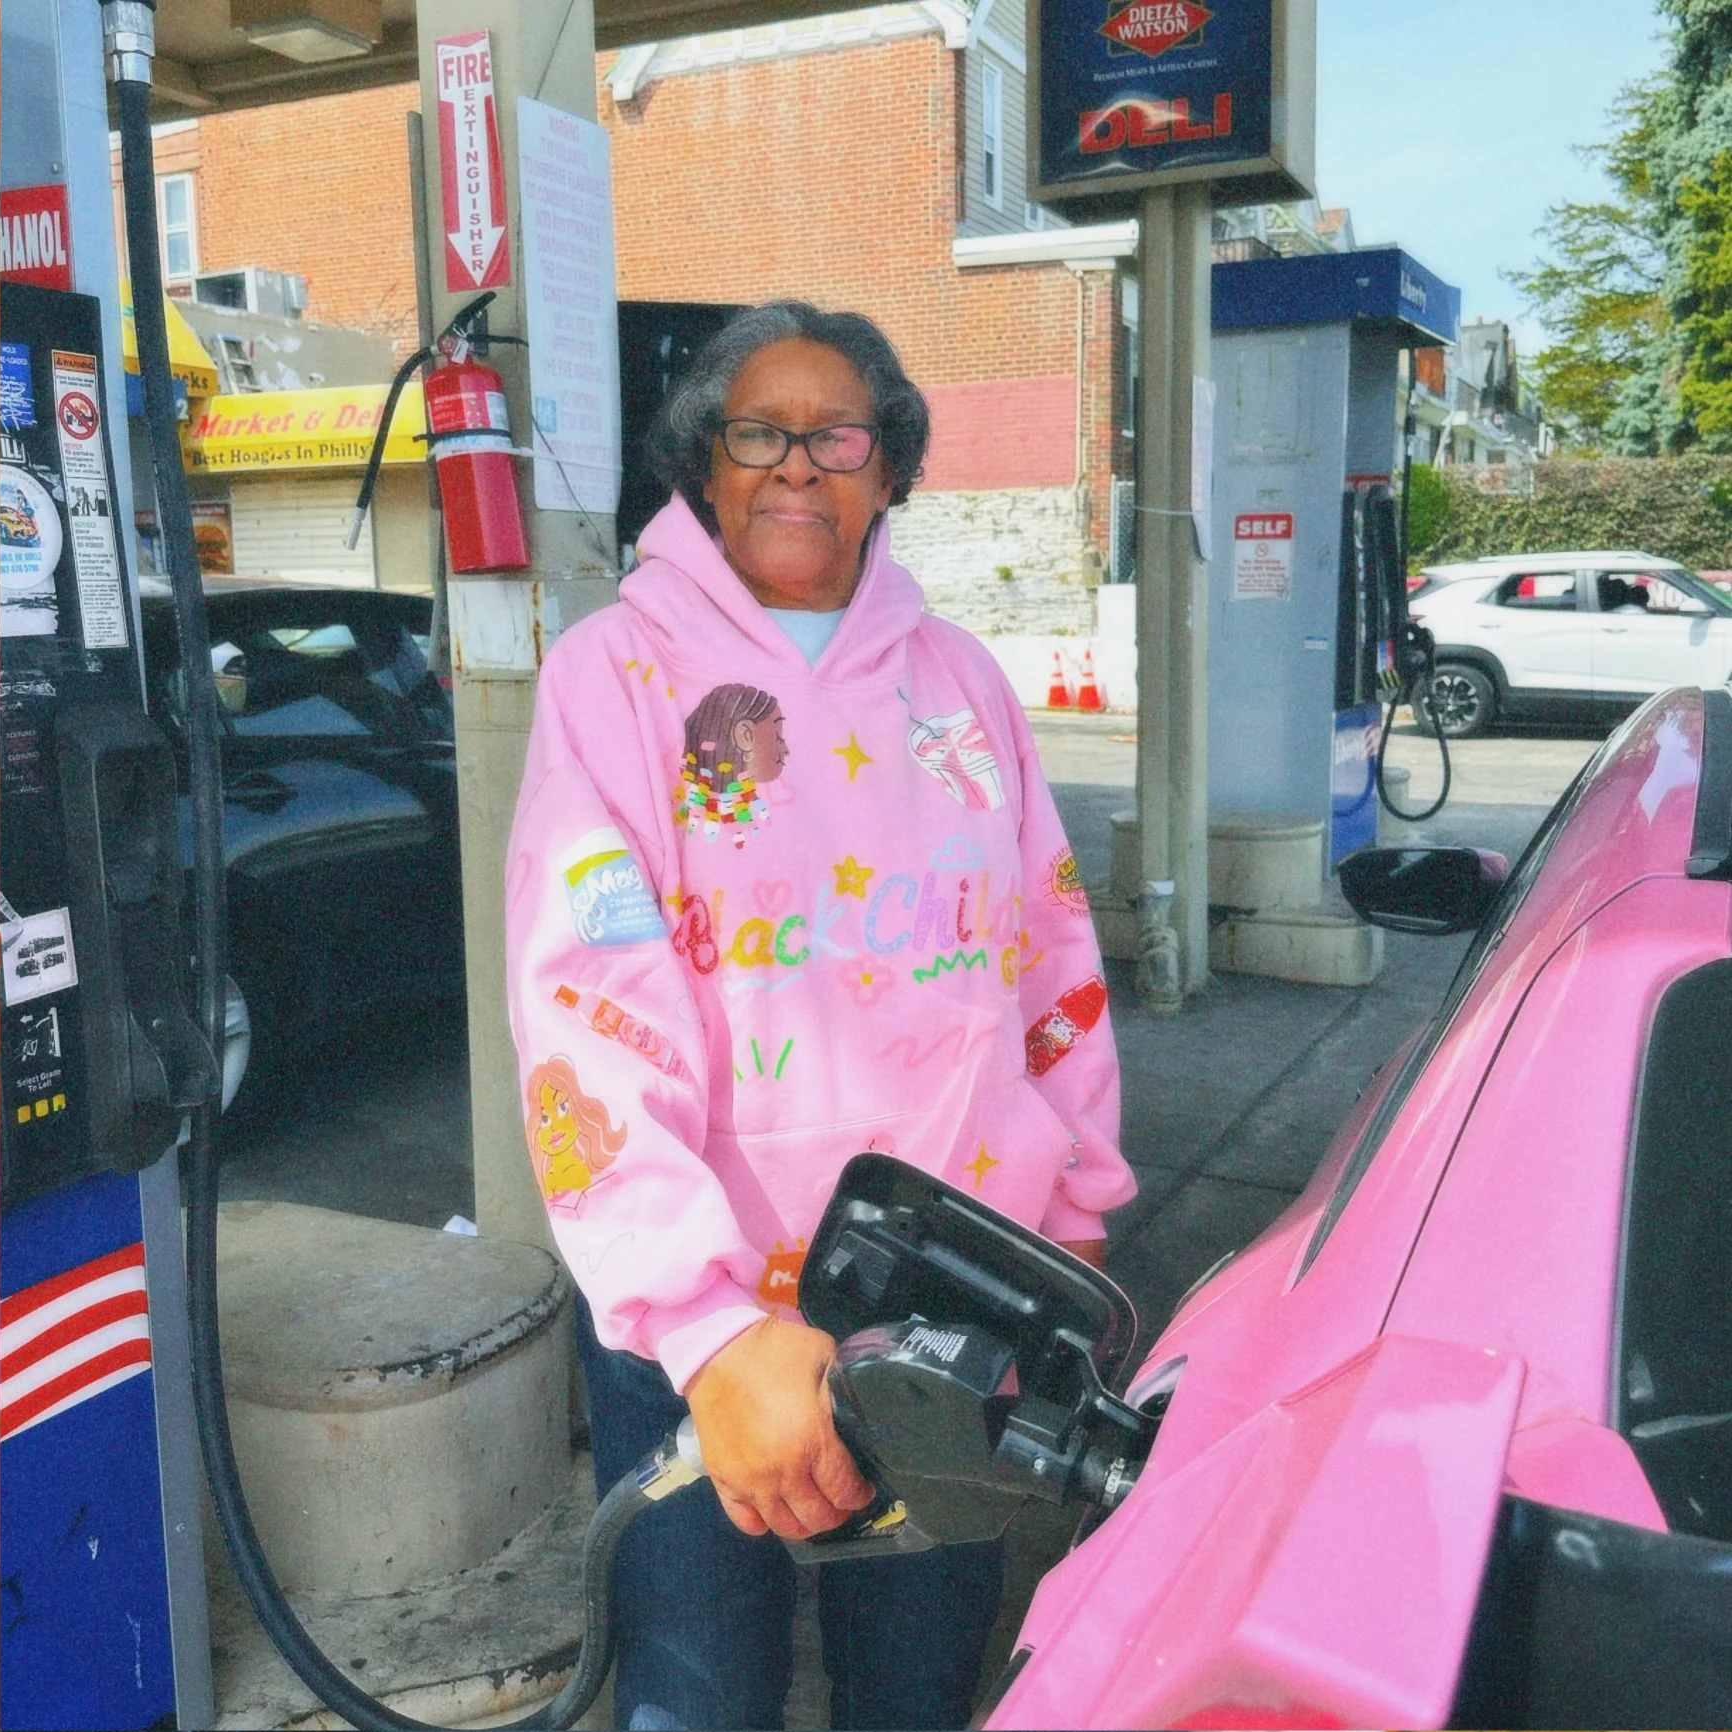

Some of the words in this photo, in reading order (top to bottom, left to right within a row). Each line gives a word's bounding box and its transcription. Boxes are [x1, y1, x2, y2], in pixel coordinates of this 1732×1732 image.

[1129, 5, 1173, 23] DIETZ
[1174, 3, 1188, 18] &
[1118, 18, 1188, 40] WATSON
[442, 50, 491, 90] FIRE
[1079, 92, 1232, 154] DELI
[464, 89, 484, 271] EXTINGUISHER
[193, 410, 295, 439] Market
[303, 410, 323, 432] &
[333, 403, 383, 429] Del
[297, 446, 313, 459] In
[1238, 520, 1287, 536] SELF
[672, 879, 858, 976] Black
[16, 1075, 39, 1087] Select
[40, 1069, 61, 1081] Grade
[38, 1080, 52, 1091] Left
